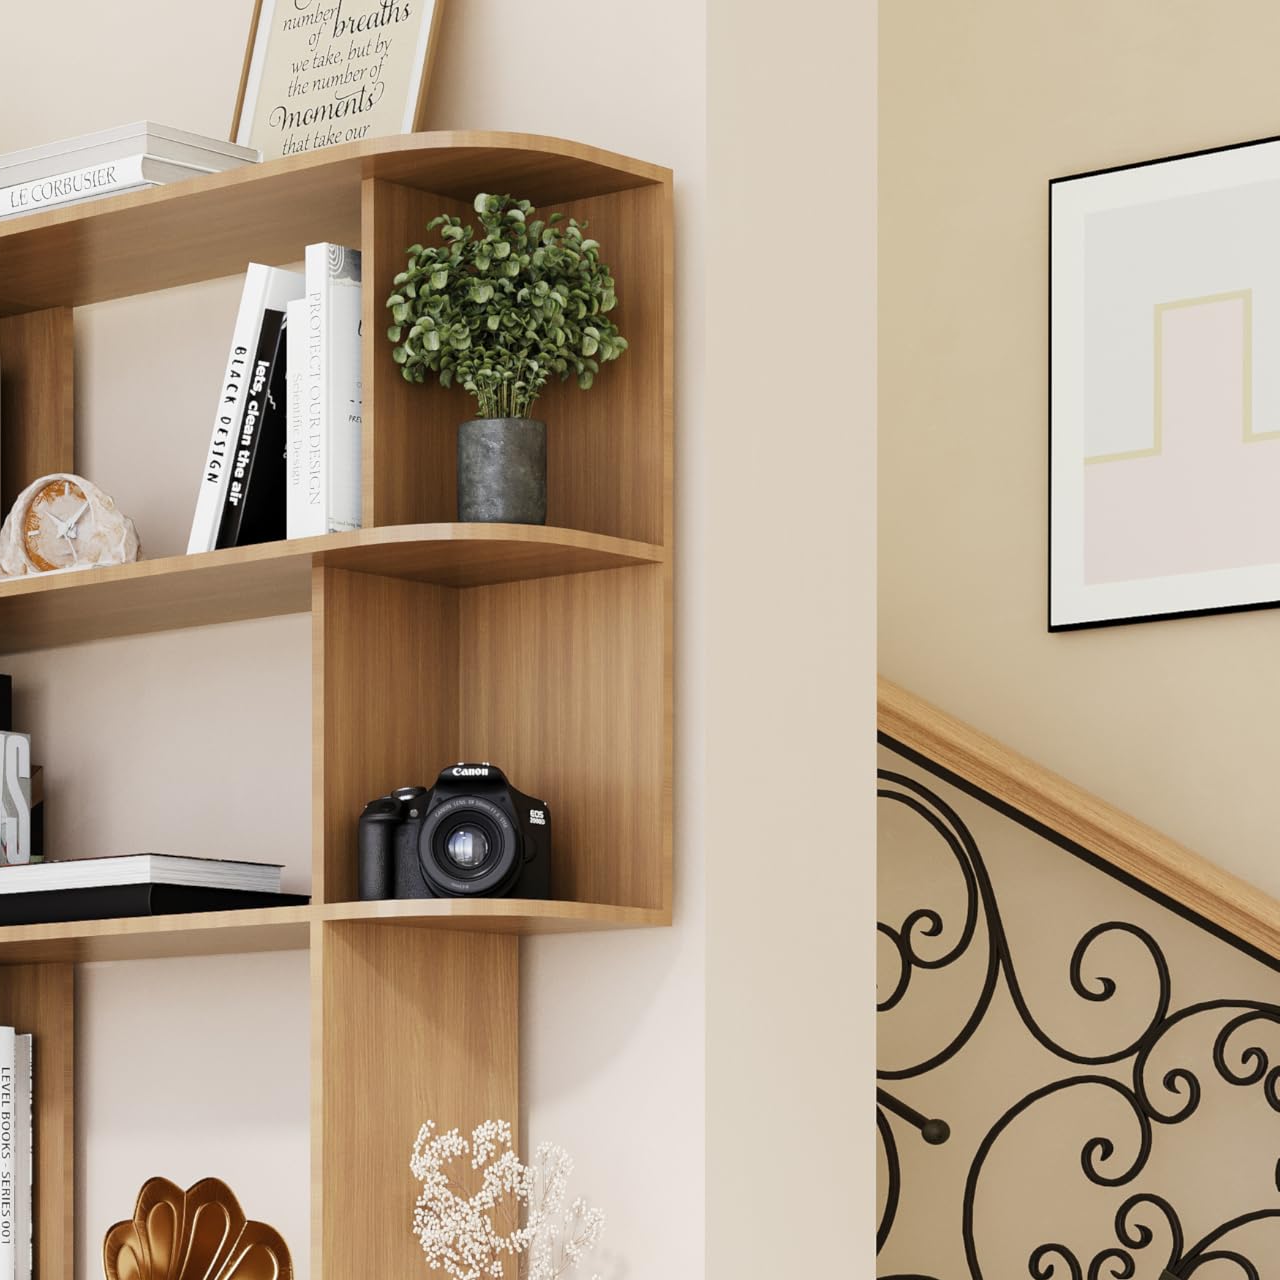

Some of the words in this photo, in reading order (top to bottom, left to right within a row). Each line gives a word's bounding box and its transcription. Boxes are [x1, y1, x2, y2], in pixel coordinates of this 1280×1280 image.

[284, 3, 337, 31] number
[333, 0, 411, 38] breaths
[309, 22, 327, 51] of
[292, 60, 309, 74] we
[313, 45, 343, 69] take,
[348, 38, 371, 60] but
[375, 33, 392, 54] by
[288, 79, 309, 98] the
[313, 64, 368, 90] number
[370, 54, 388, 84] of
[283, 137, 310, 155] that
[314, 125, 342, 148] take
[345, 124, 370, 142] our
[10, 188, 28, 208] LE
[31, 165, 118, 203] CORBUSIER
[309, 292, 321, 377] PROTECT
[225, 345, 247, 405] BLACK
[249, 360, 270, 396] lets,
[239, 401, 260, 447] clean
[309, 385, 321, 429] OUR
[207, 416, 232, 484] DESIGN
[234, 449, 251, 478] the
[309, 434, 321, 505] DESIGN
[228, 480, 243, 506] air
[452, 768, 488, 776] Canon
[530, 809, 544, 818] EOS
[1, 1067, 11, 1107] LEVEL
[1, 1111, 11, 1160] BOOKS
[1, 1171, 11, 1218] SERIES
[1, 1220, 11, 1245] 001
